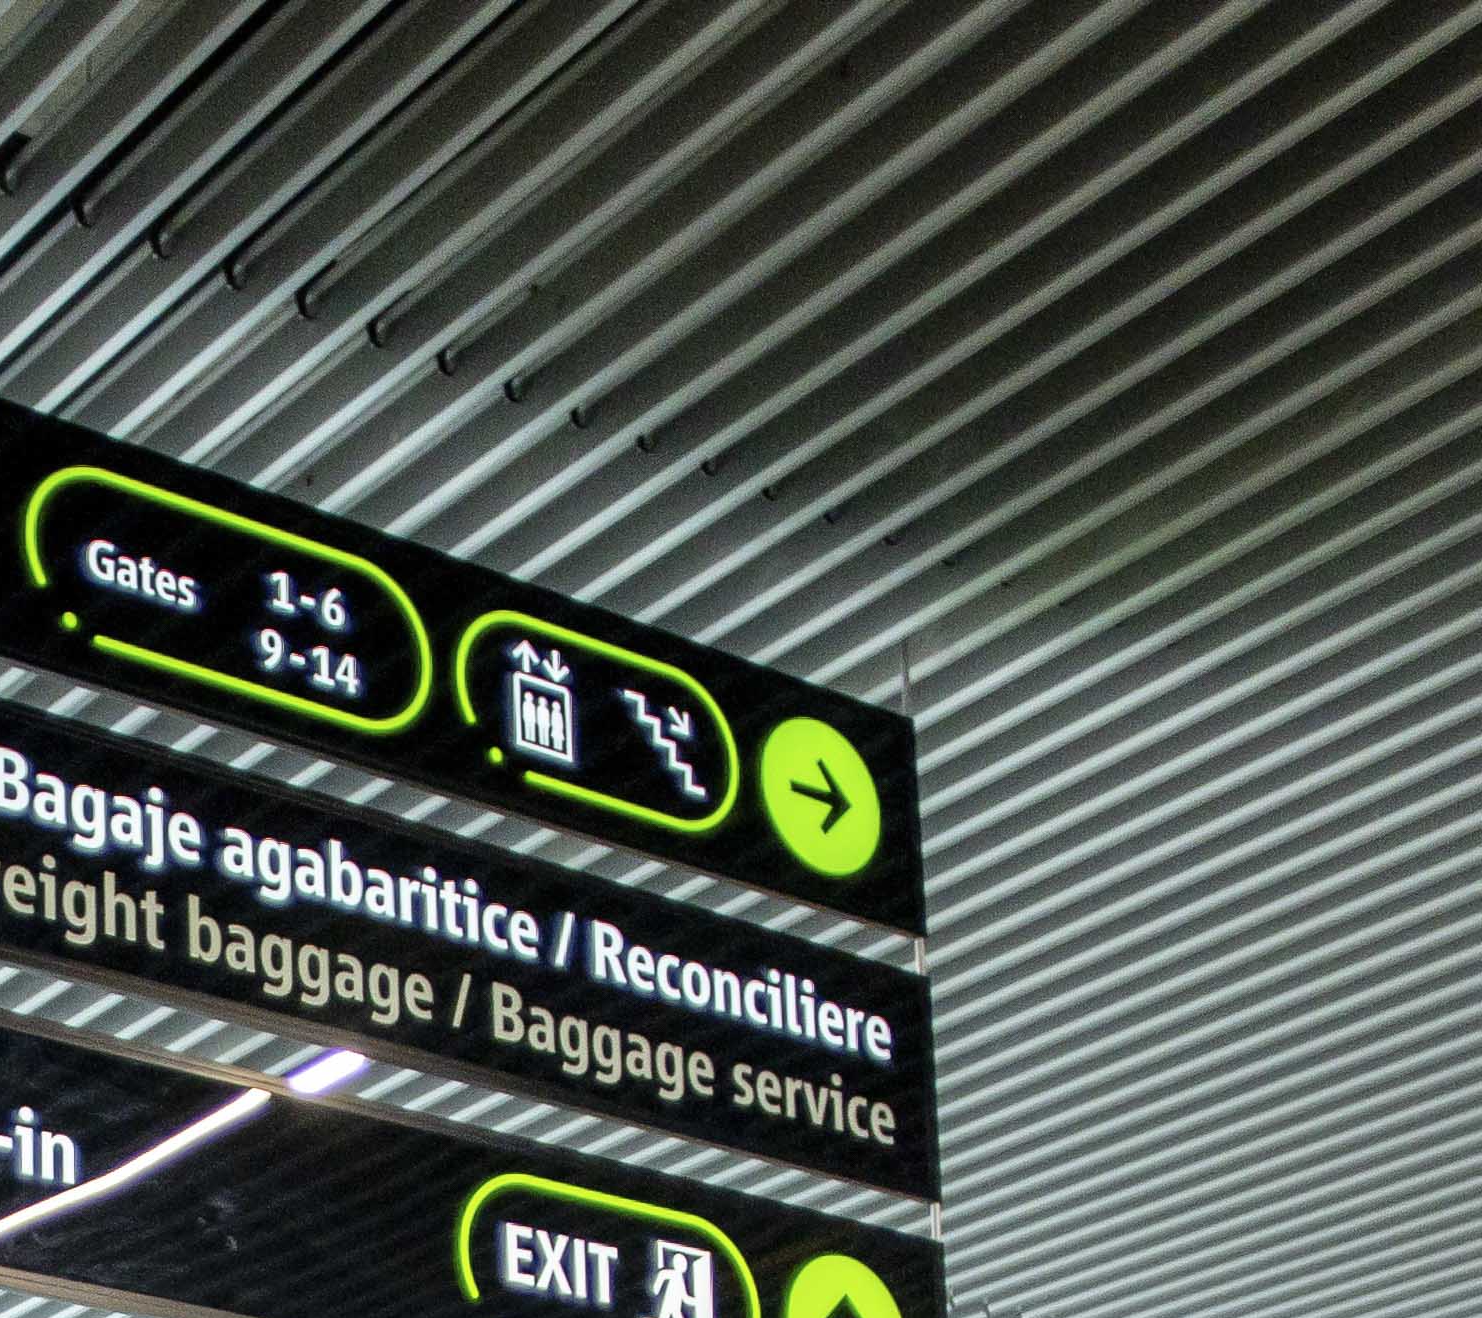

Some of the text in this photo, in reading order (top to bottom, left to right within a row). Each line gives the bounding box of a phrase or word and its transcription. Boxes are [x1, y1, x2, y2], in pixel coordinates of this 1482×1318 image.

[85, 538, 346, 629] Gates 1-6
[257, 628, 361, 697] 9-14
[222, 825, 540, 960] agabaritice
[551, 911, 576, 970] /
[590, 921, 894, 1061] Reconciliere
[190, 895, 435, 1028] baggage
[451, 973, 469, 1029] /
[493, 981, 714, 1102] Baggage
[732, 1056, 896, 1146] service
[504, 1222, 618, 1305] EXIT
